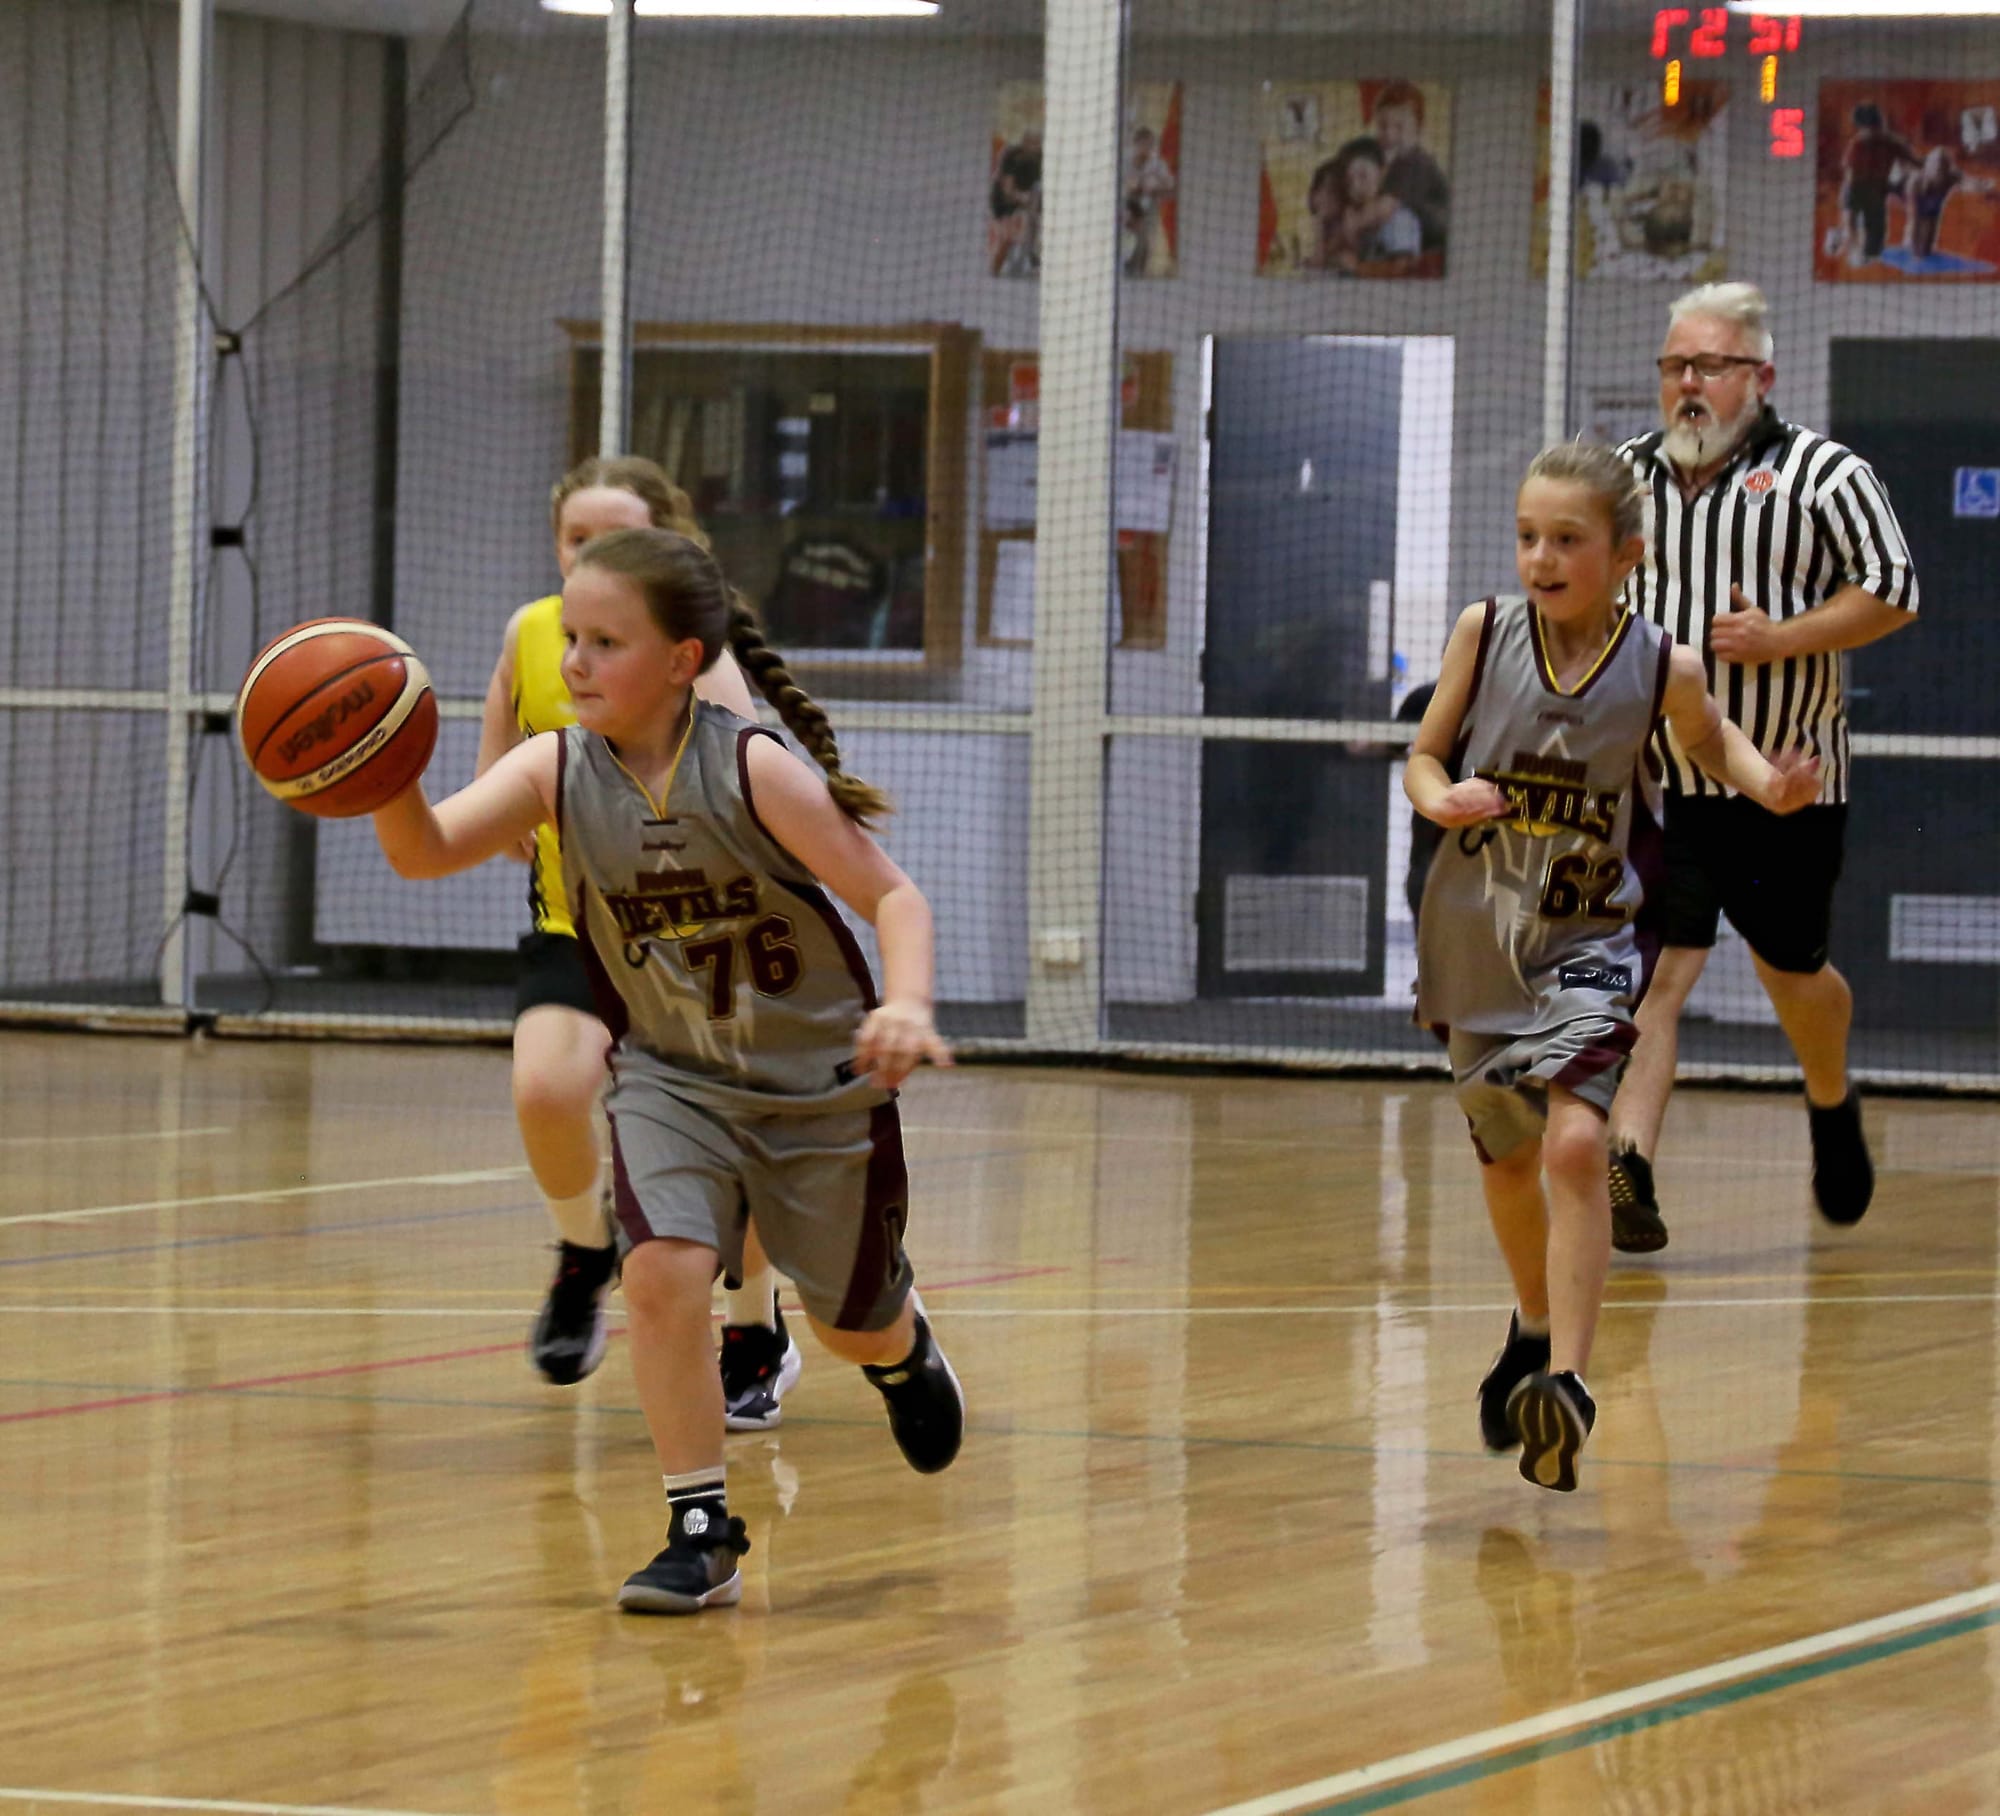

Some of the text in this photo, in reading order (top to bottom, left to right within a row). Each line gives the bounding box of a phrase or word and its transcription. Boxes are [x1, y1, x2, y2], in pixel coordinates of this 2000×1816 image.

[1474, 768, 1624, 844] EVILS
[603, 872, 758, 938] DEVILS
[1539, 853, 1630, 922] 62
[681, 913, 804, 1021] 76
